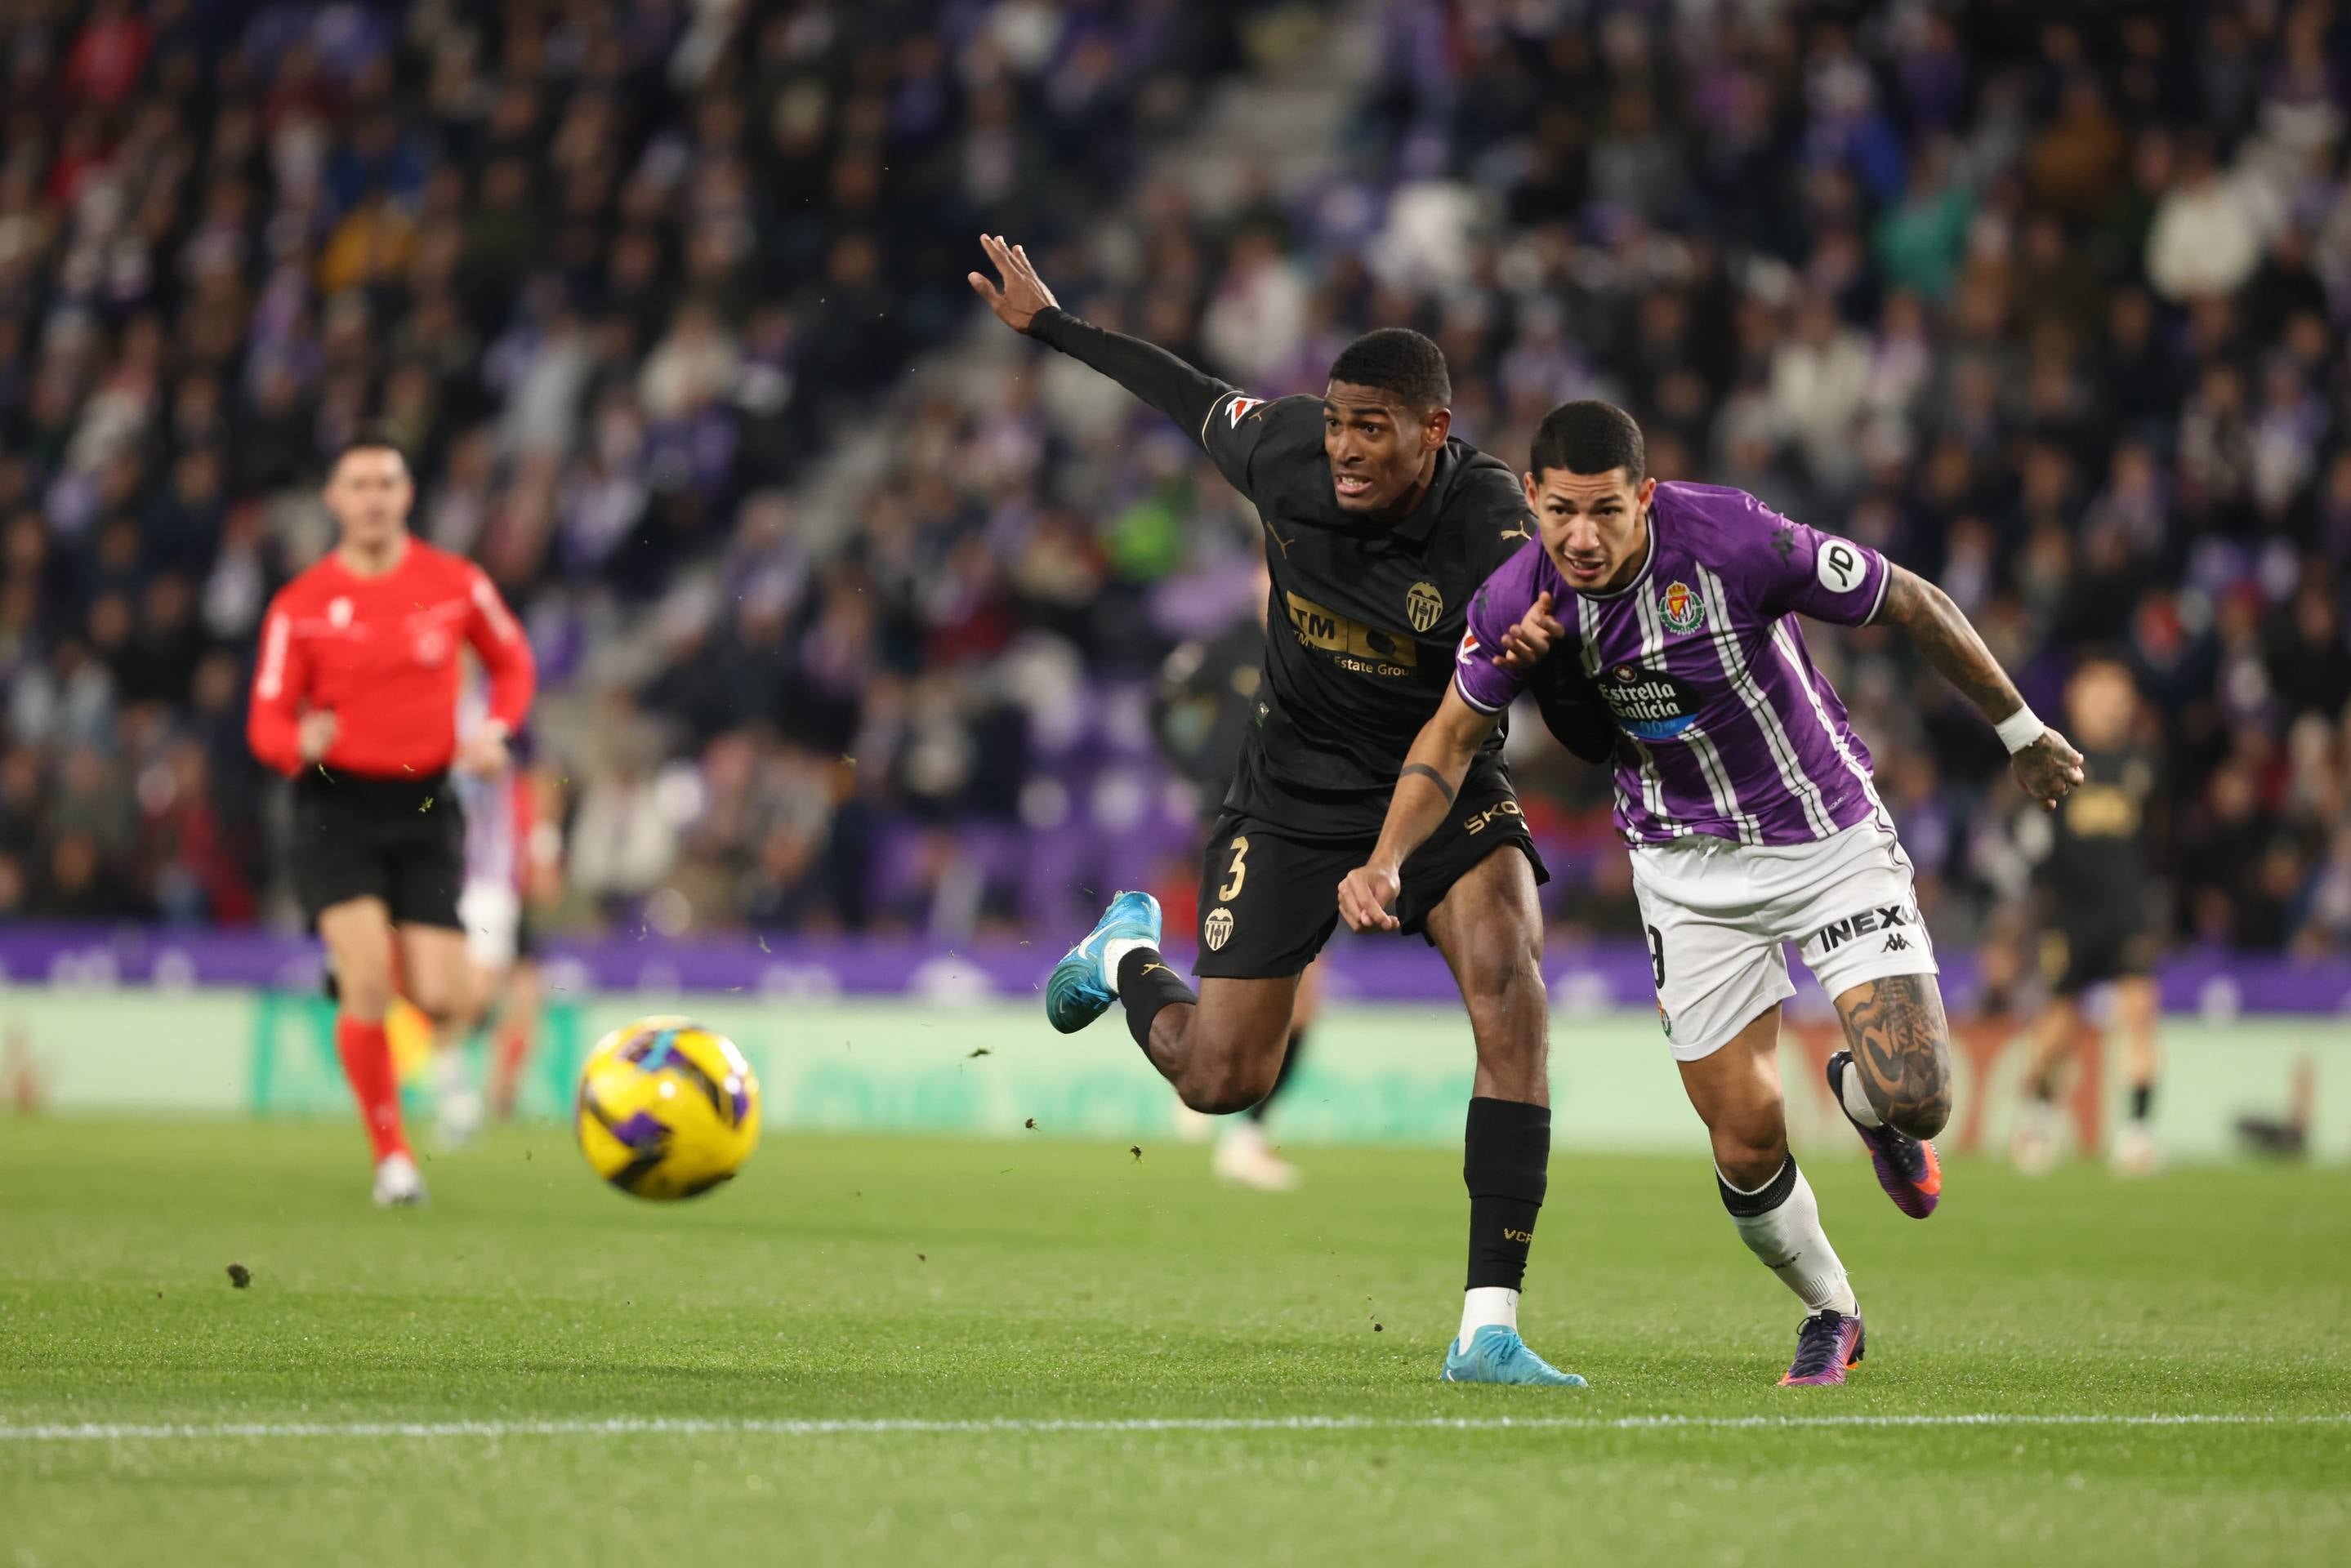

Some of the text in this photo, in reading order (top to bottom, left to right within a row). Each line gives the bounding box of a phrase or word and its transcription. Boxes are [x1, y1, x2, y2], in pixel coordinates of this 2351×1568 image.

[1829, 546, 1854, 587] JD
[1294, 607, 1335, 639] TM
[1334, 655, 1374, 674] Estate
[1377, 664, 1413, 677] Grou
[1598, 681, 1676, 702] Estrella
[1609, 699, 1681, 719] Galicia
[1219, 835, 1249, 902] 3
